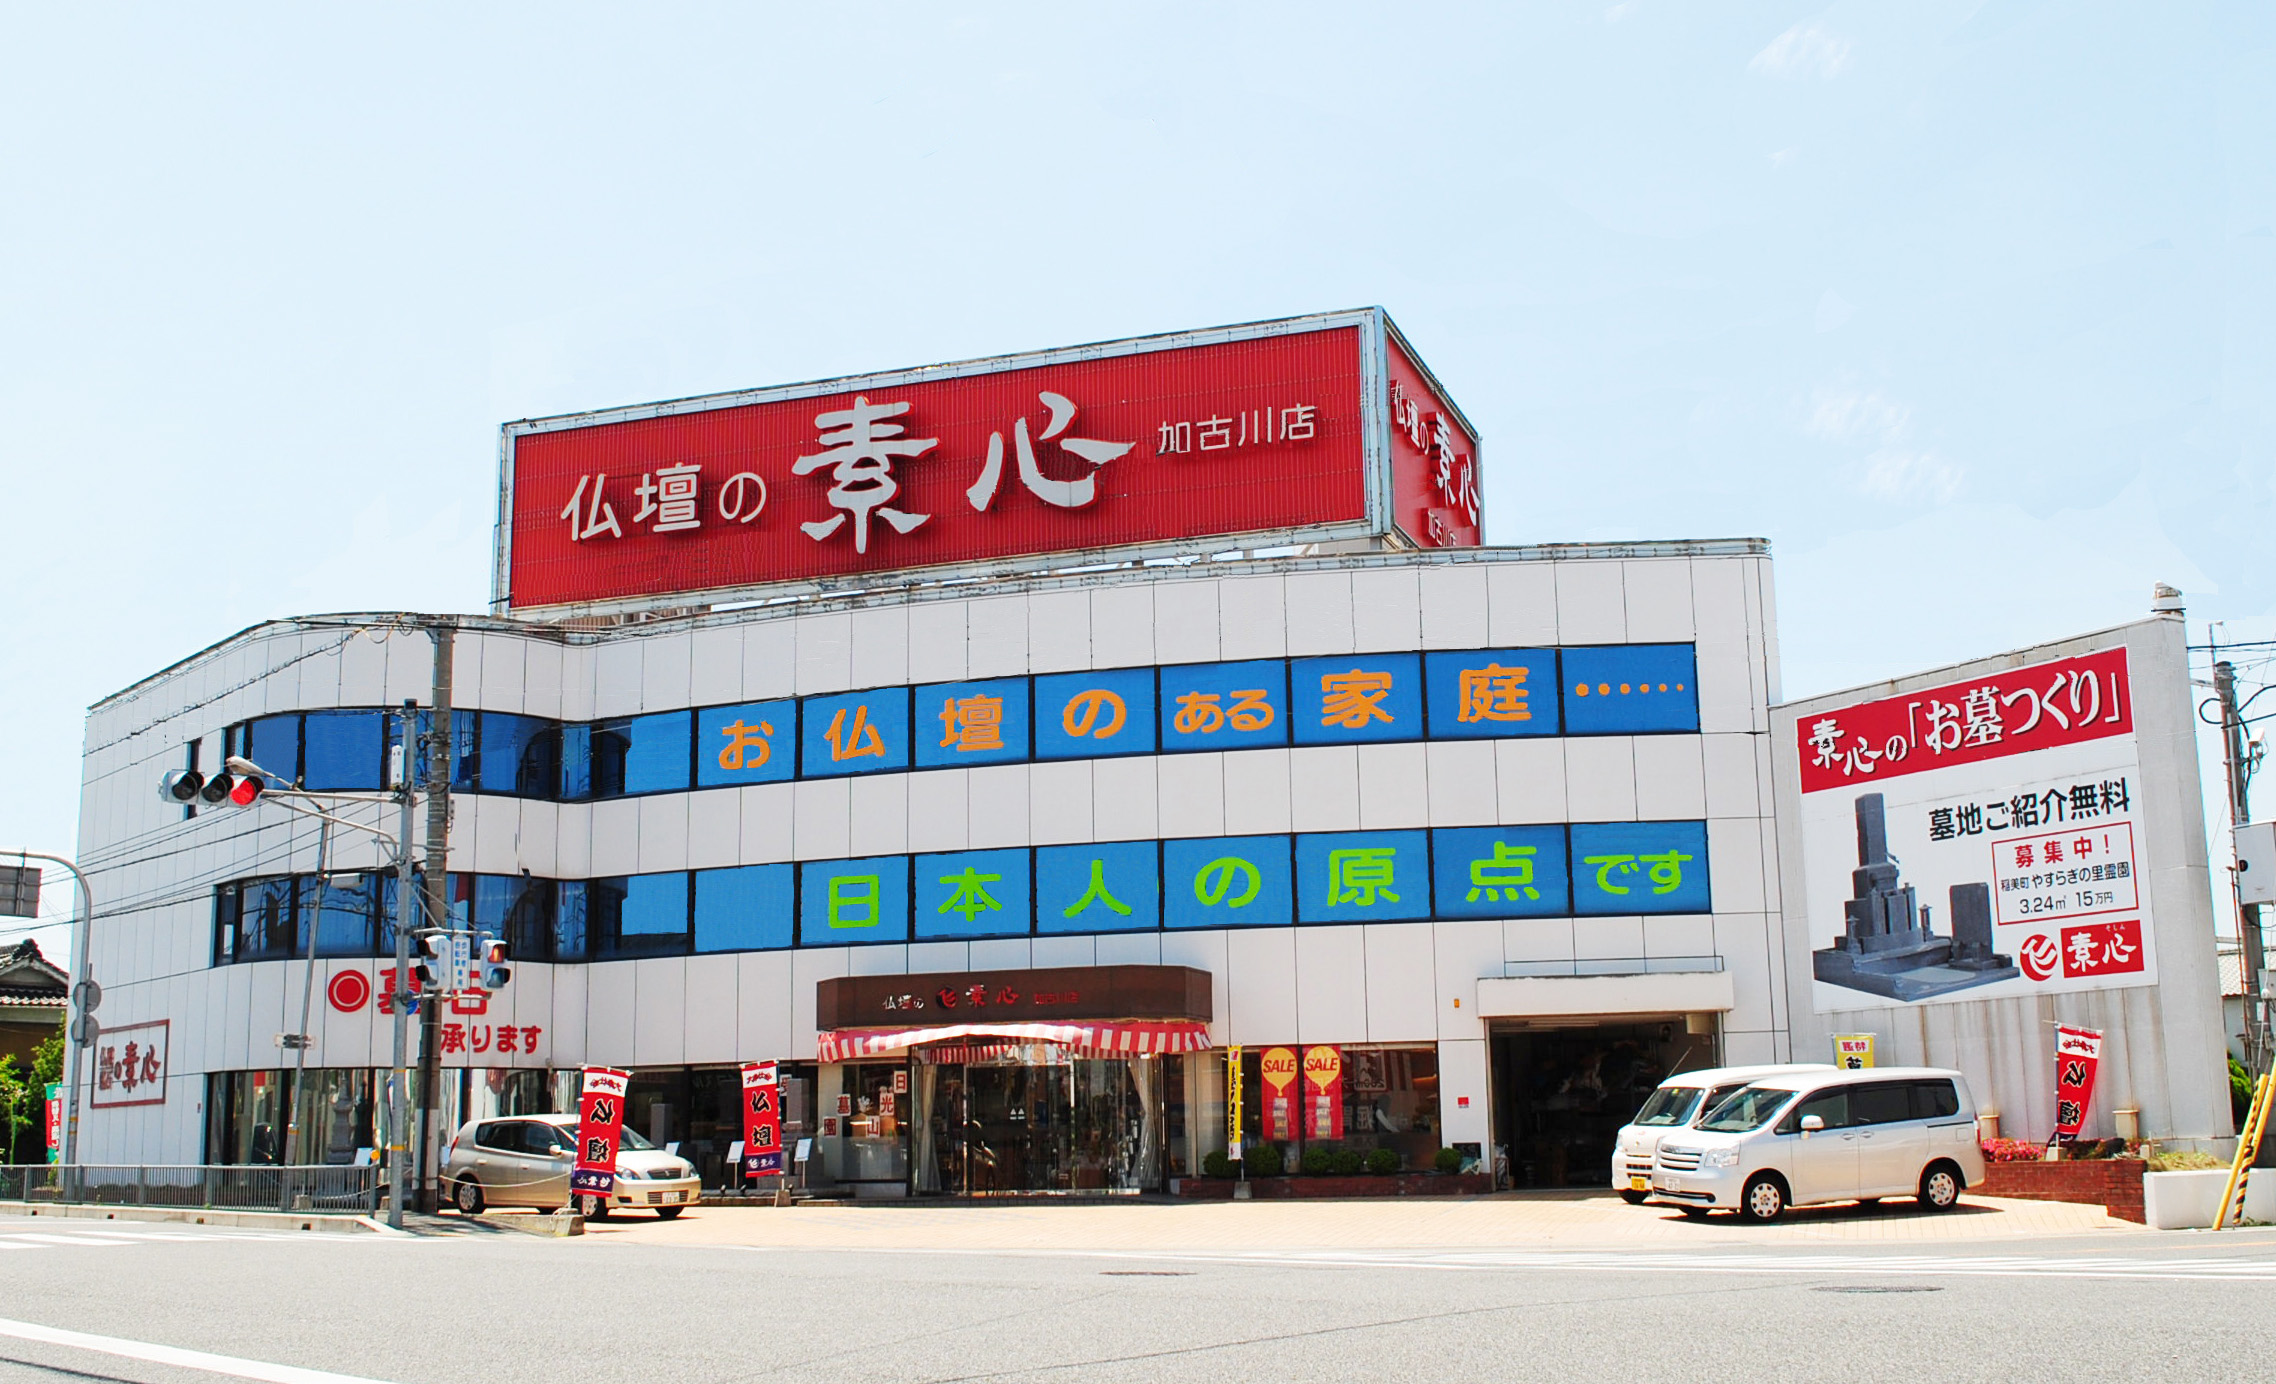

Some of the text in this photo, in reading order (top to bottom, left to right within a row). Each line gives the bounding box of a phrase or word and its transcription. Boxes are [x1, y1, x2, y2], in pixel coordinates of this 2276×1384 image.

[560, 391, 1318, 554] 仏壇の 素心 加古川店
[1390, 379, 1480, 527] 仏壇の 素心
[1808, 668, 2121, 776] 素心の「お墓つくり」
[1928, 776, 2131, 842] 墓地ご紹介無料
[827, 840, 1693, 929] 日本人の原点です
[2032, 862, 2130, 889] やすらぎの里霊園
[2076, 891, 2114, 907] 15万円
[2067, 931, 2137, 973] 素心
[441, 1023, 542, 1054] 承ります
[1262, 1058, 1296, 1073] SALE
[1304, 1057, 1339, 1072] SALE
[750, 1089, 774, 1147] 仏壇
